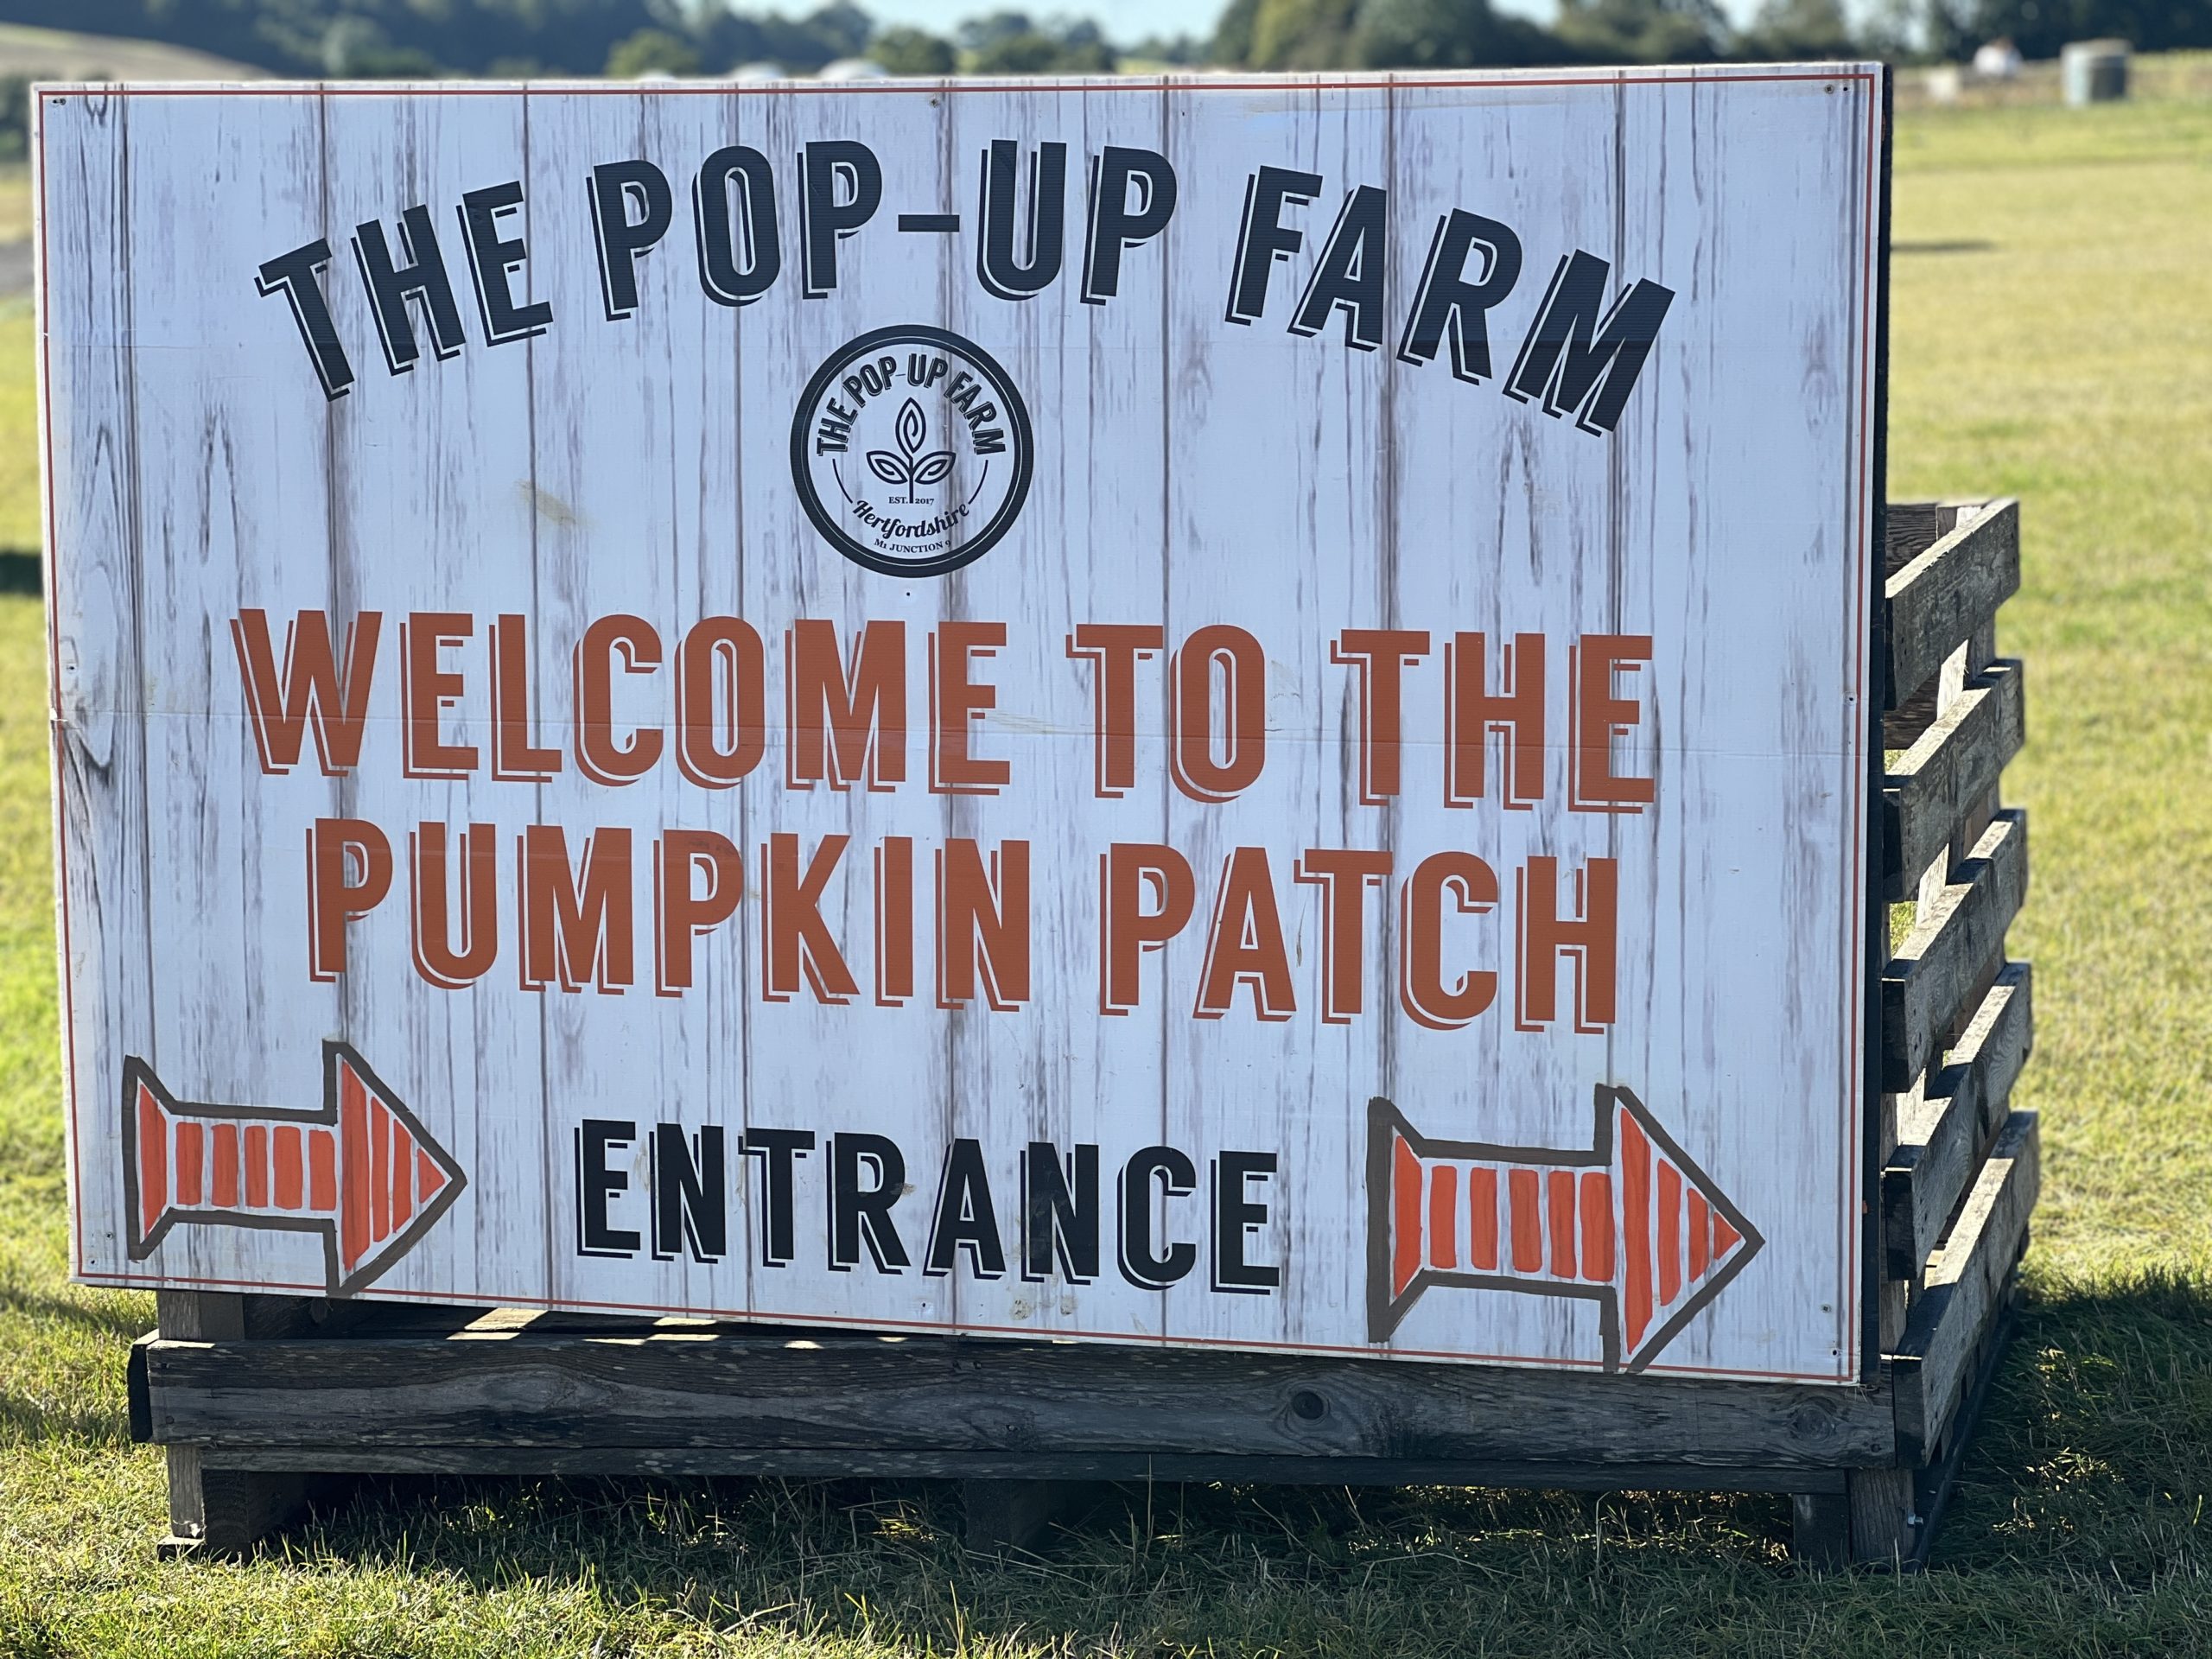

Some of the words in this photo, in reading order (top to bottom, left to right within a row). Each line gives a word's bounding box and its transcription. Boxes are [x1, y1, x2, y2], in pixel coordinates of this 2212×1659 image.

[254, 180, 554, 403] THE
[586, 139, 1178, 321] POP-UP
[1224, 165, 1676, 438] FARM
[817, 397, 858, 457] THE
[943, 370, 1007, 455] FARM
[852, 499, 969, 540] Hertfordshire
[888, 496, 909, 505] EST.
[889, 541, 944, 553] JUNCTION
[944, 539, 951, 548] 9
[230, 608, 1011, 796] WELCOME
[1065, 624, 1266, 804] TO
[1330, 629, 1655, 814] THE
[306, 817, 1031, 1013] PUMPKIN
[1099, 842, 1618, 1036] PATCH
[575, 1119, 1281, 1296] ENTRANCE
